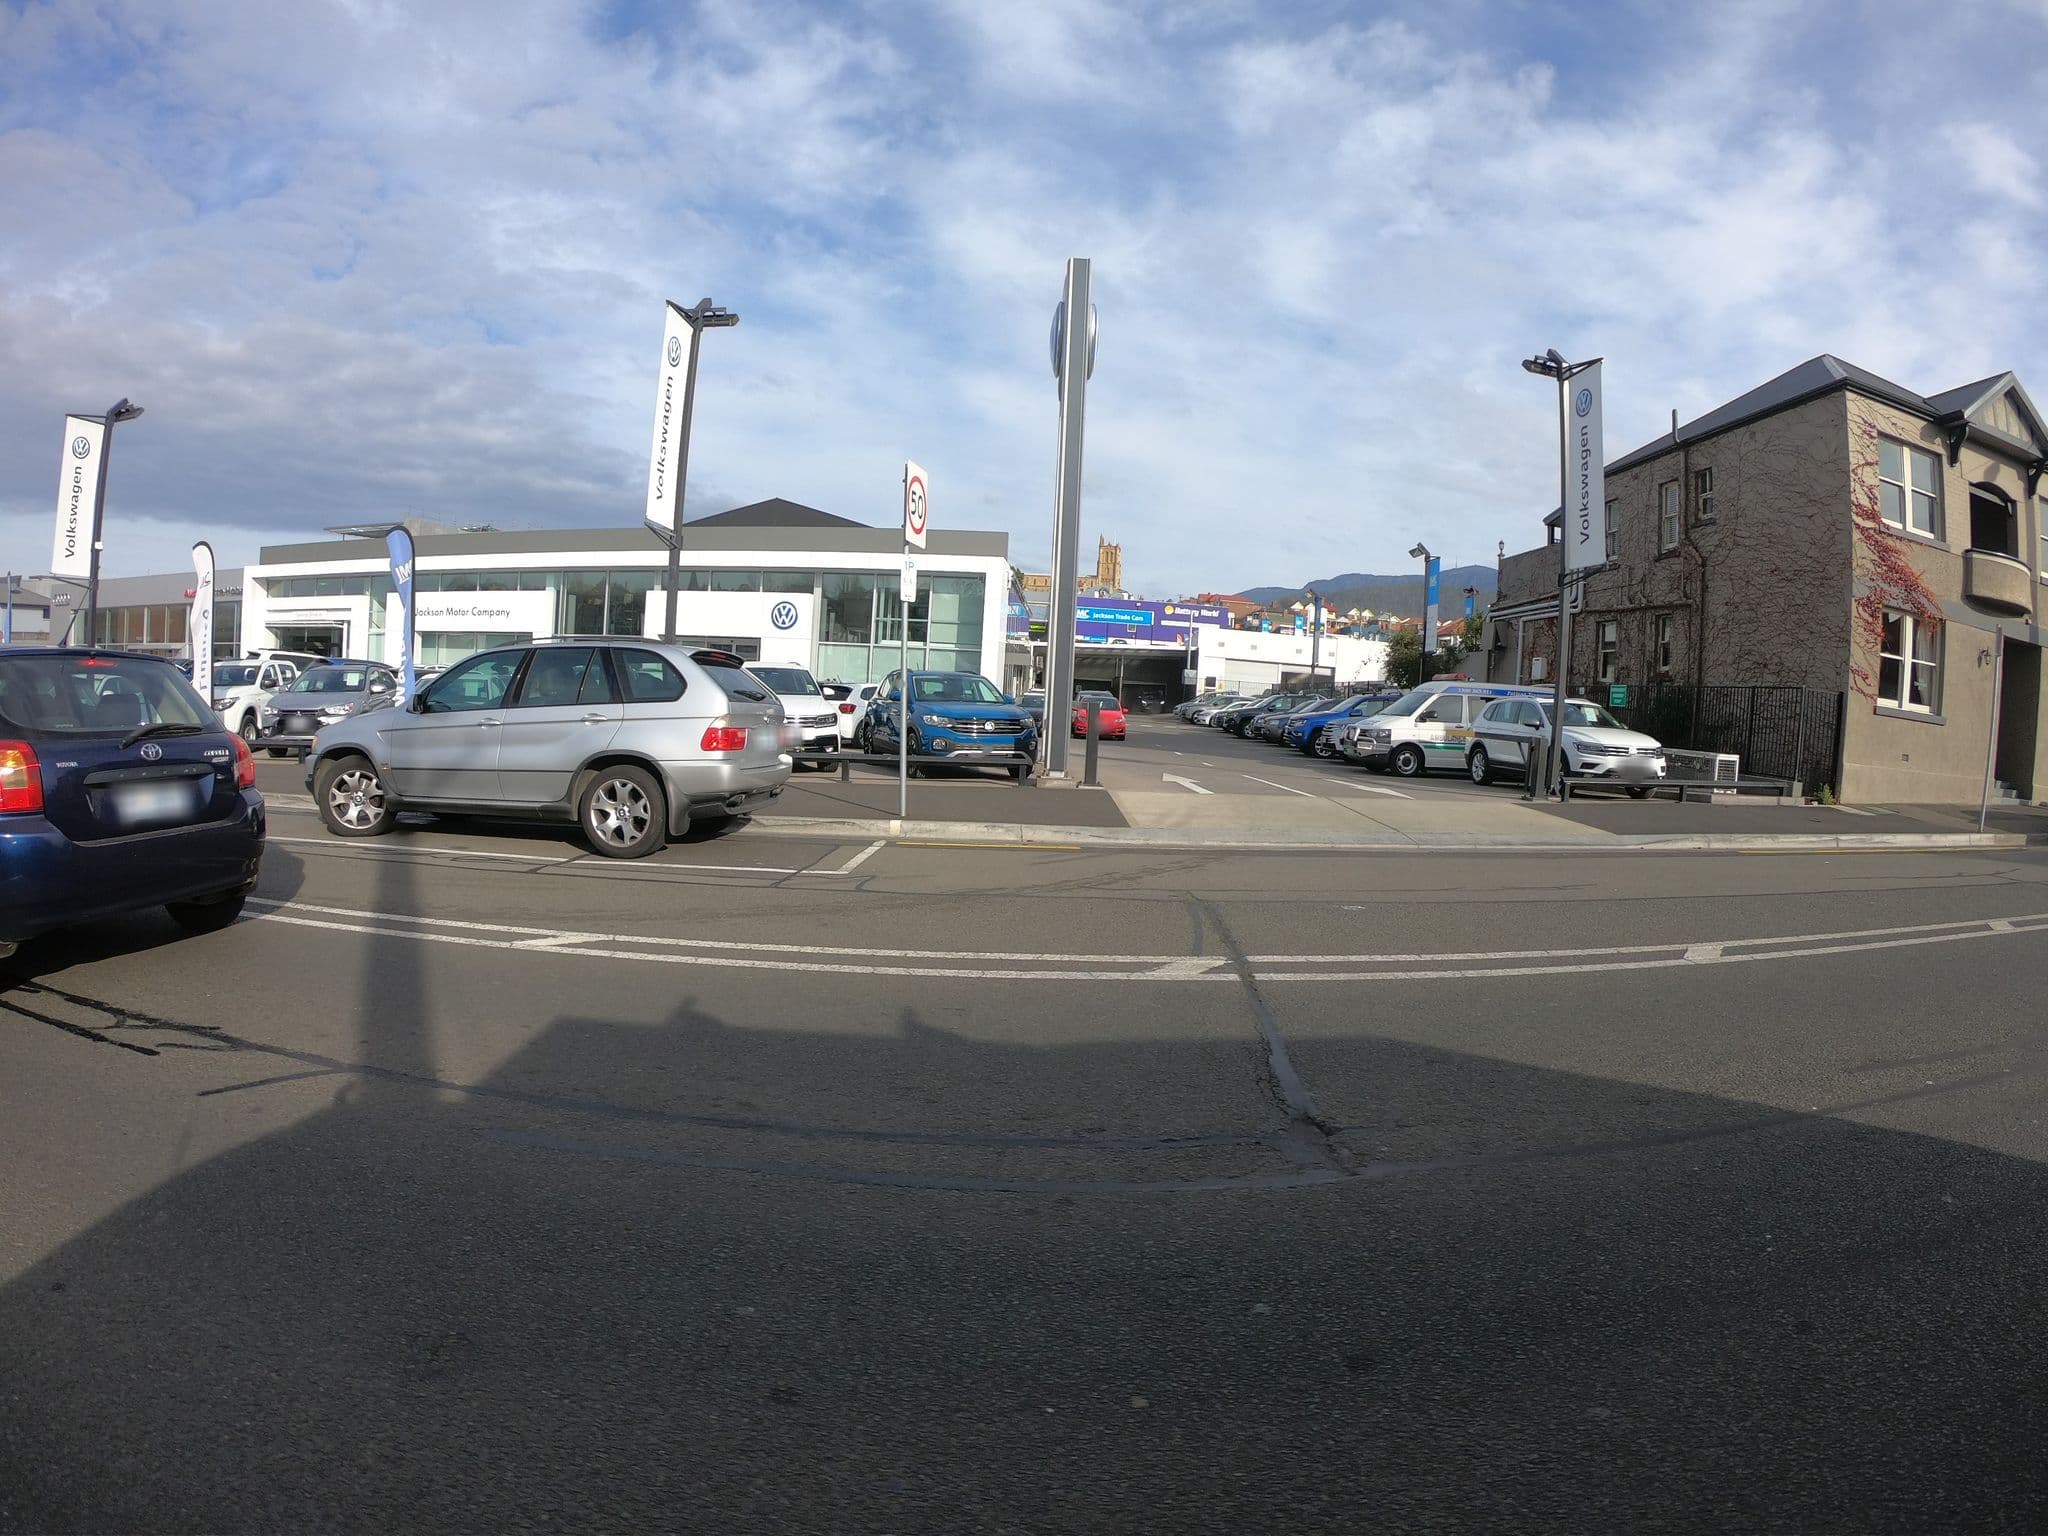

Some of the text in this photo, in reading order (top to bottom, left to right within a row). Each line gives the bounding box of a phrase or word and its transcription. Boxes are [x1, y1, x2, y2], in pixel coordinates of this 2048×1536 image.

[655, 375, 674, 501] Volkswagen
[1579, 424, 1592, 546] Volkswagen
[64, 465, 83, 559] Volkswagen
[910, 490, 924, 520] 50
[415, 606, 511, 619] Jackson Motor Company
[1093, 612, 1114, 620] Jackson
[1115, 613, 1131, 621] Trade
[1132, 614, 1144, 622] Cars
[1201, 609, 1220, 617] World
